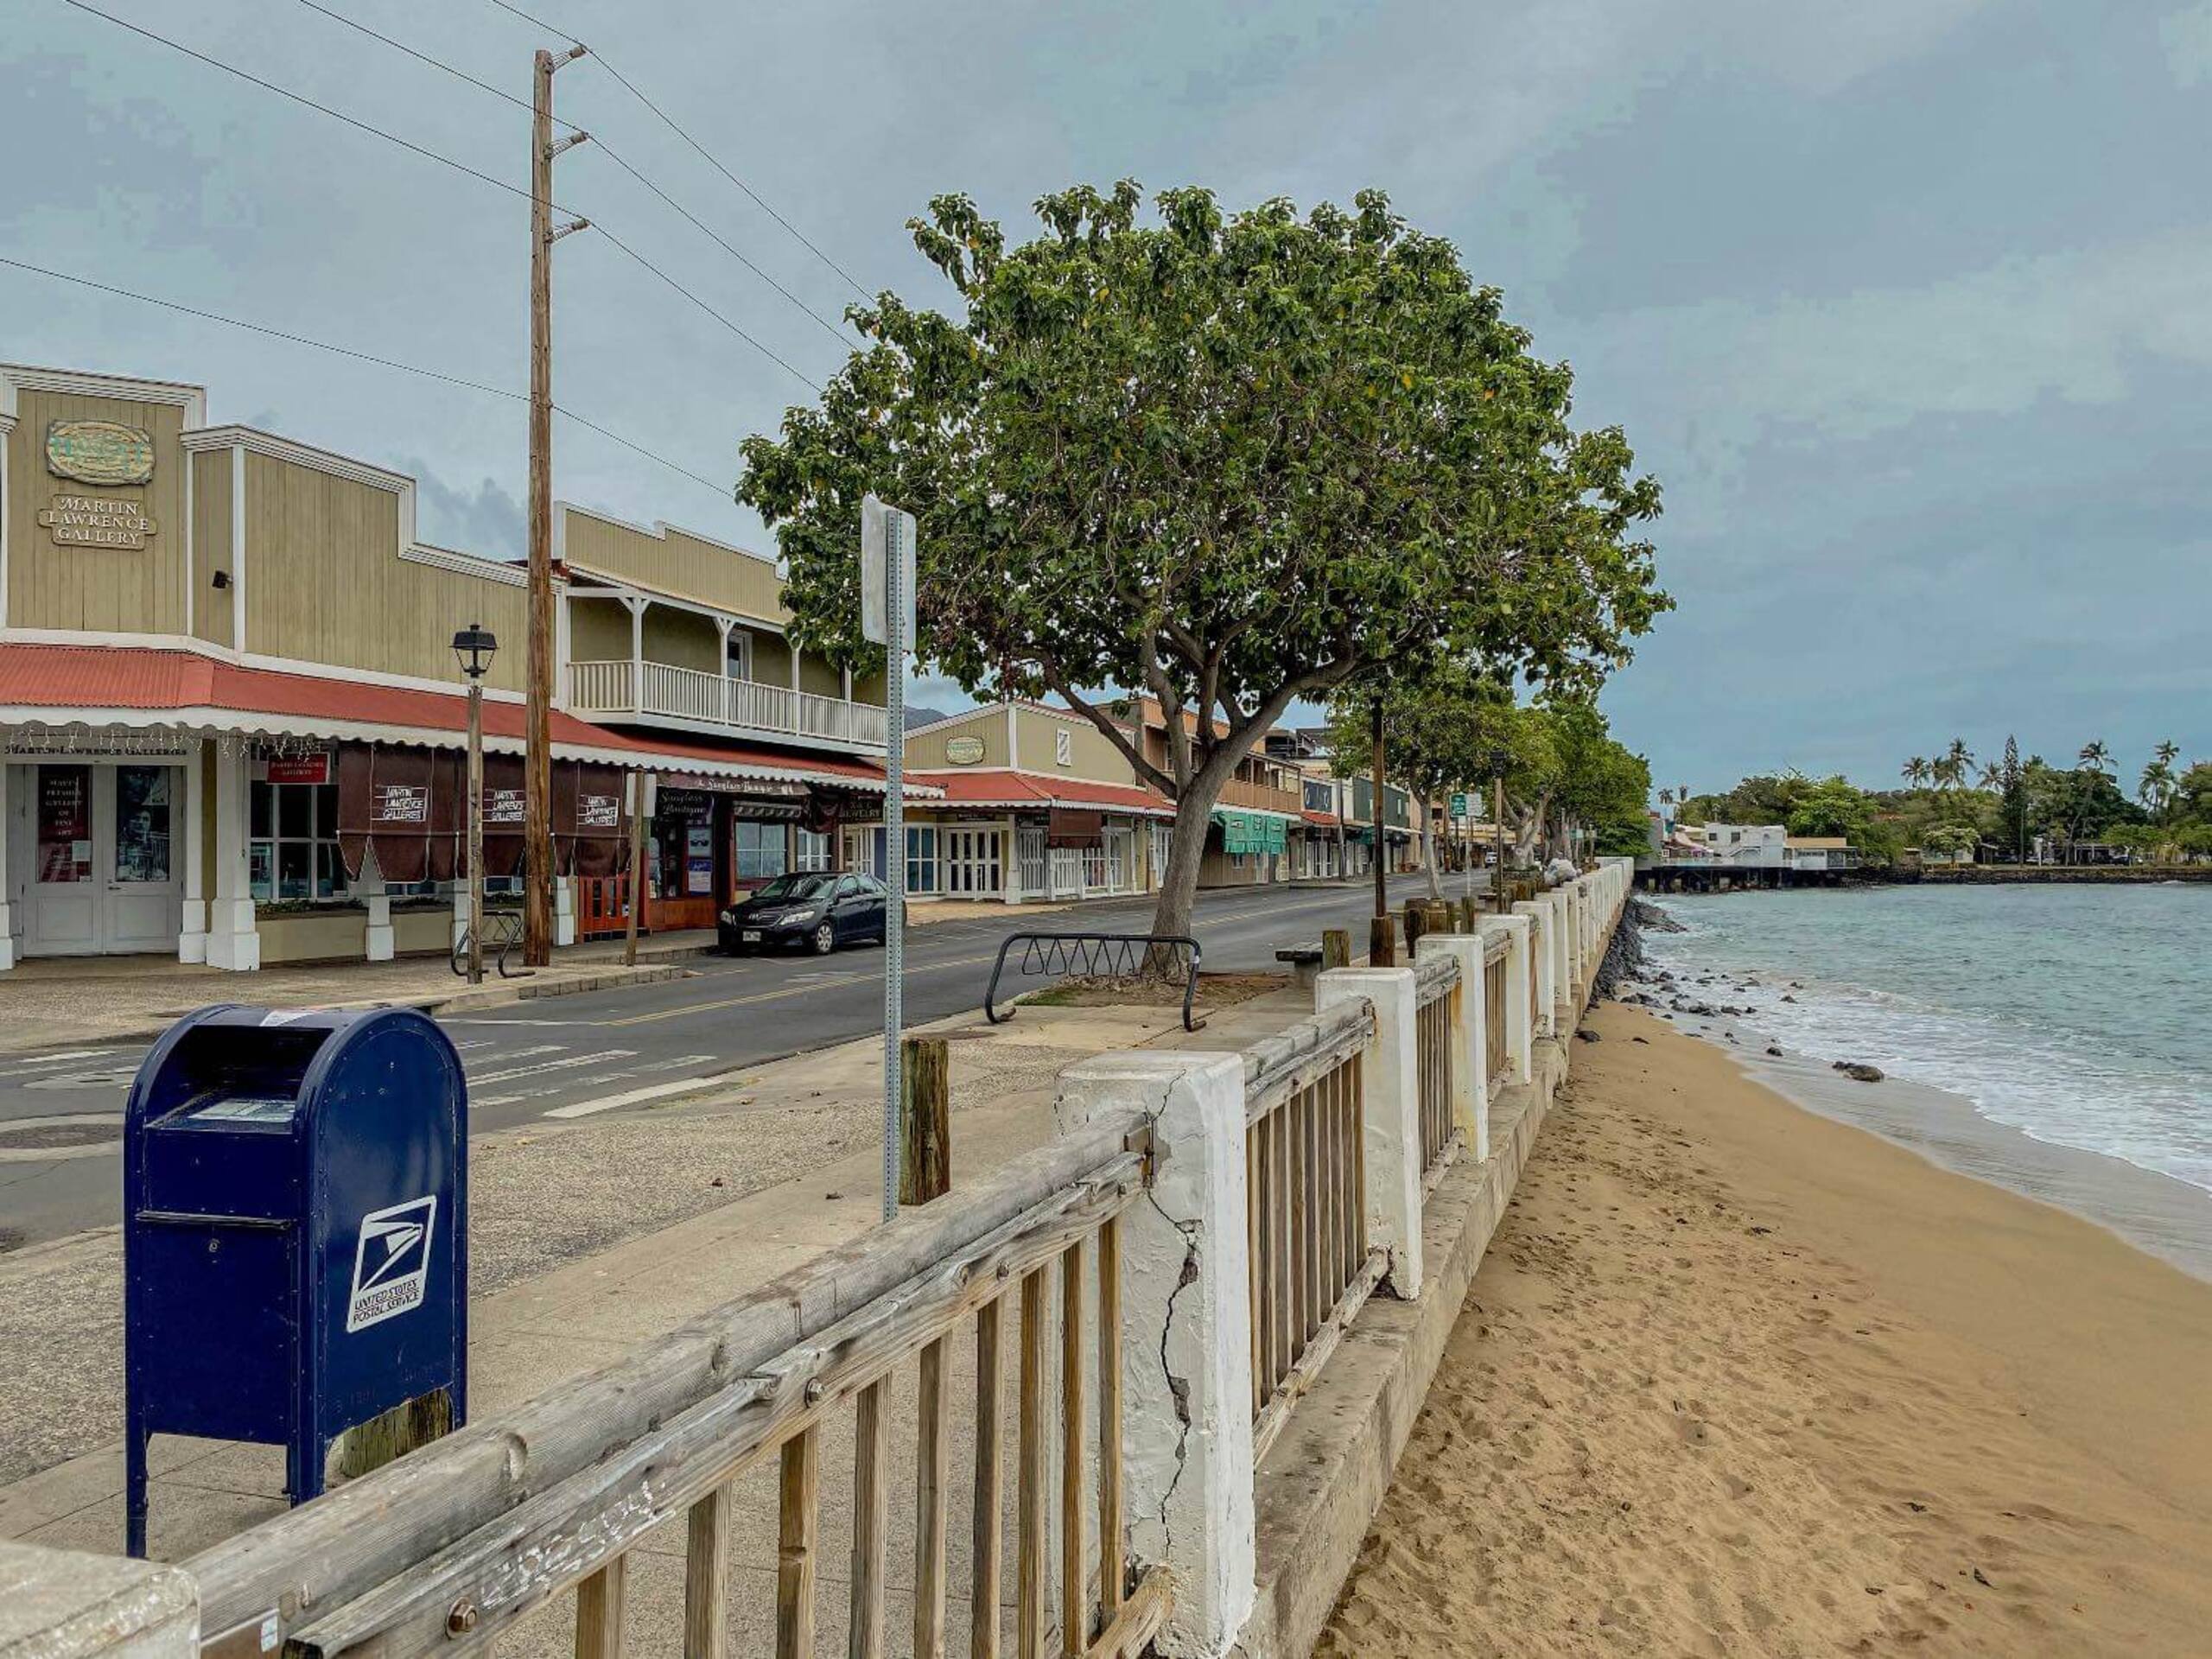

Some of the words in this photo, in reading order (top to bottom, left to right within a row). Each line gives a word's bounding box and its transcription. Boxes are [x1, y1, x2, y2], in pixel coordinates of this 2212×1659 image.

[60, 498, 138, 515] MARTIN
[49, 512, 149, 531] LAWRENCE
[58, 528, 138, 544] GALLERY
[385, 798, 424, 809] LAWRENCE
[383, 809, 421, 820] GALLERIES
[355, 1289, 388, 1310] UNITED
[389, 1280, 420, 1300] STATES
[353, 1304, 385, 1324] POSTAL
[386, 1292, 419, 1312] SERVICE
